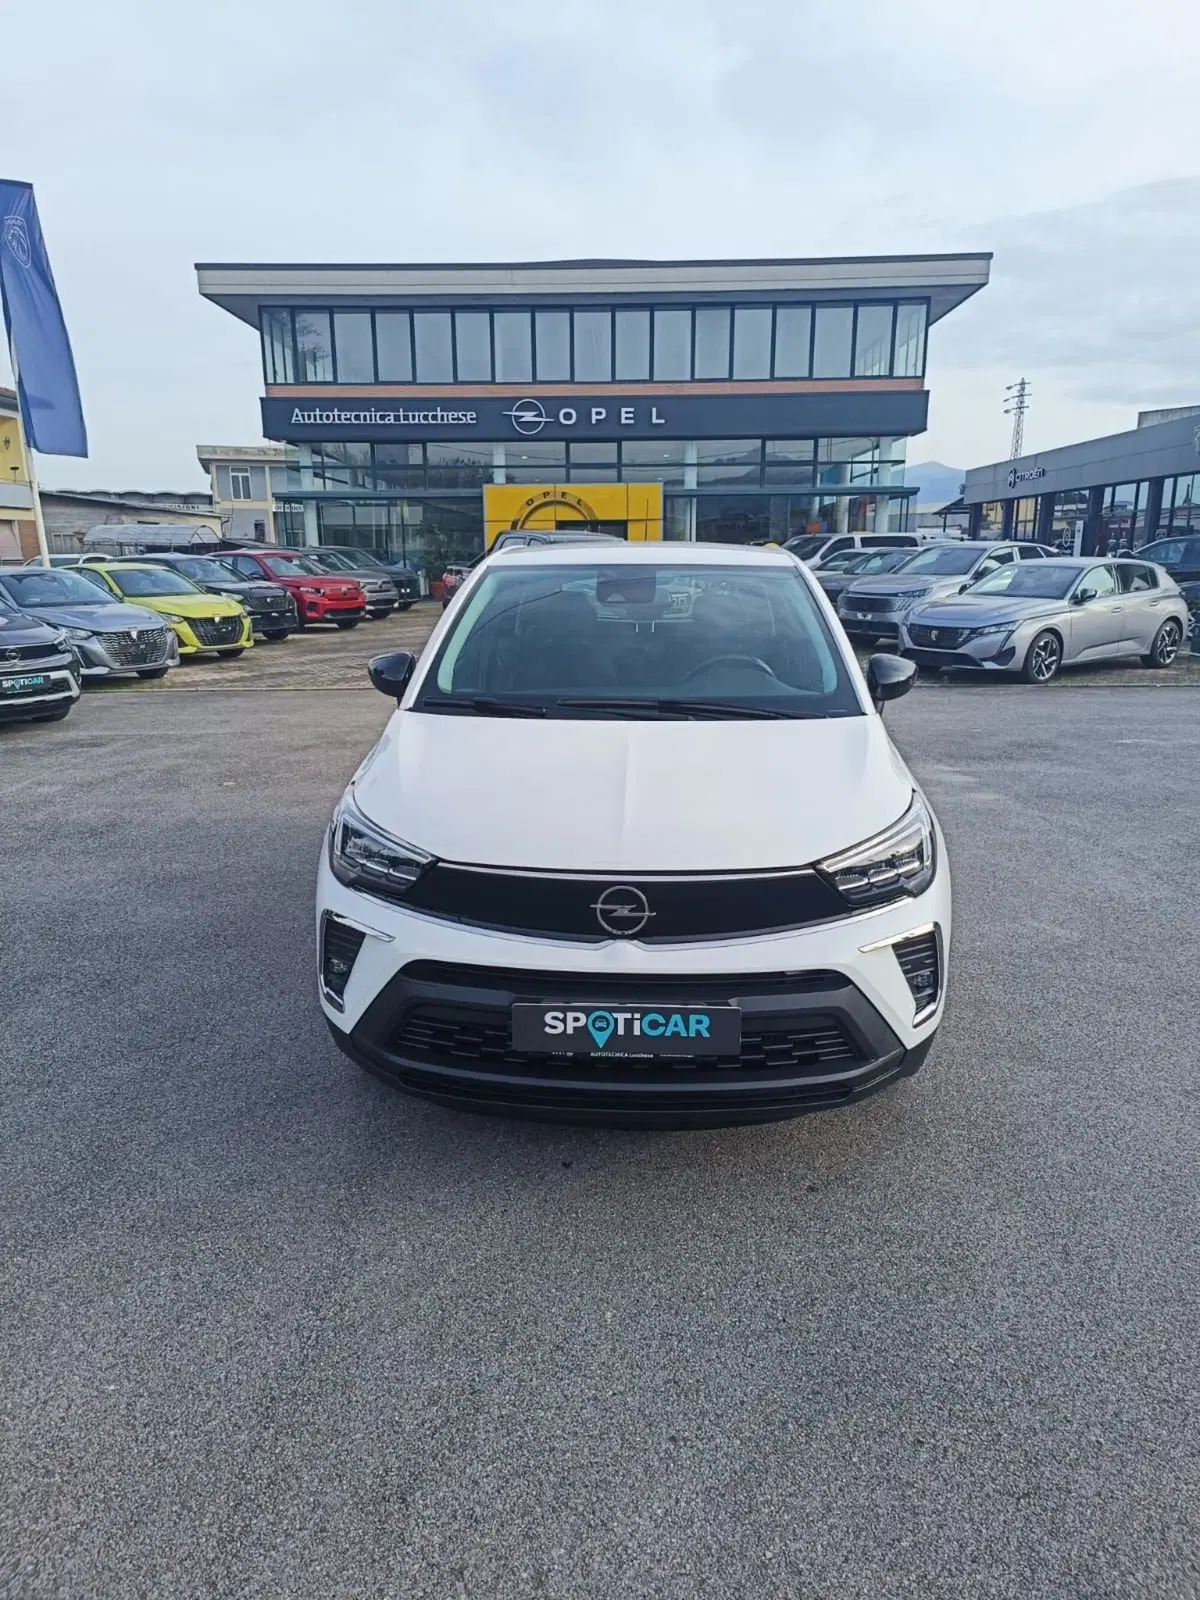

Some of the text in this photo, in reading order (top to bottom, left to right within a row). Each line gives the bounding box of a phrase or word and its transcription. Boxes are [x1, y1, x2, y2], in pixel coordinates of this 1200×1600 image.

[291, 406, 477, 424] Autotecnica Lucchese
[558, 407, 666, 425] OPEL
[526, 491, 584, 506] OPEL
